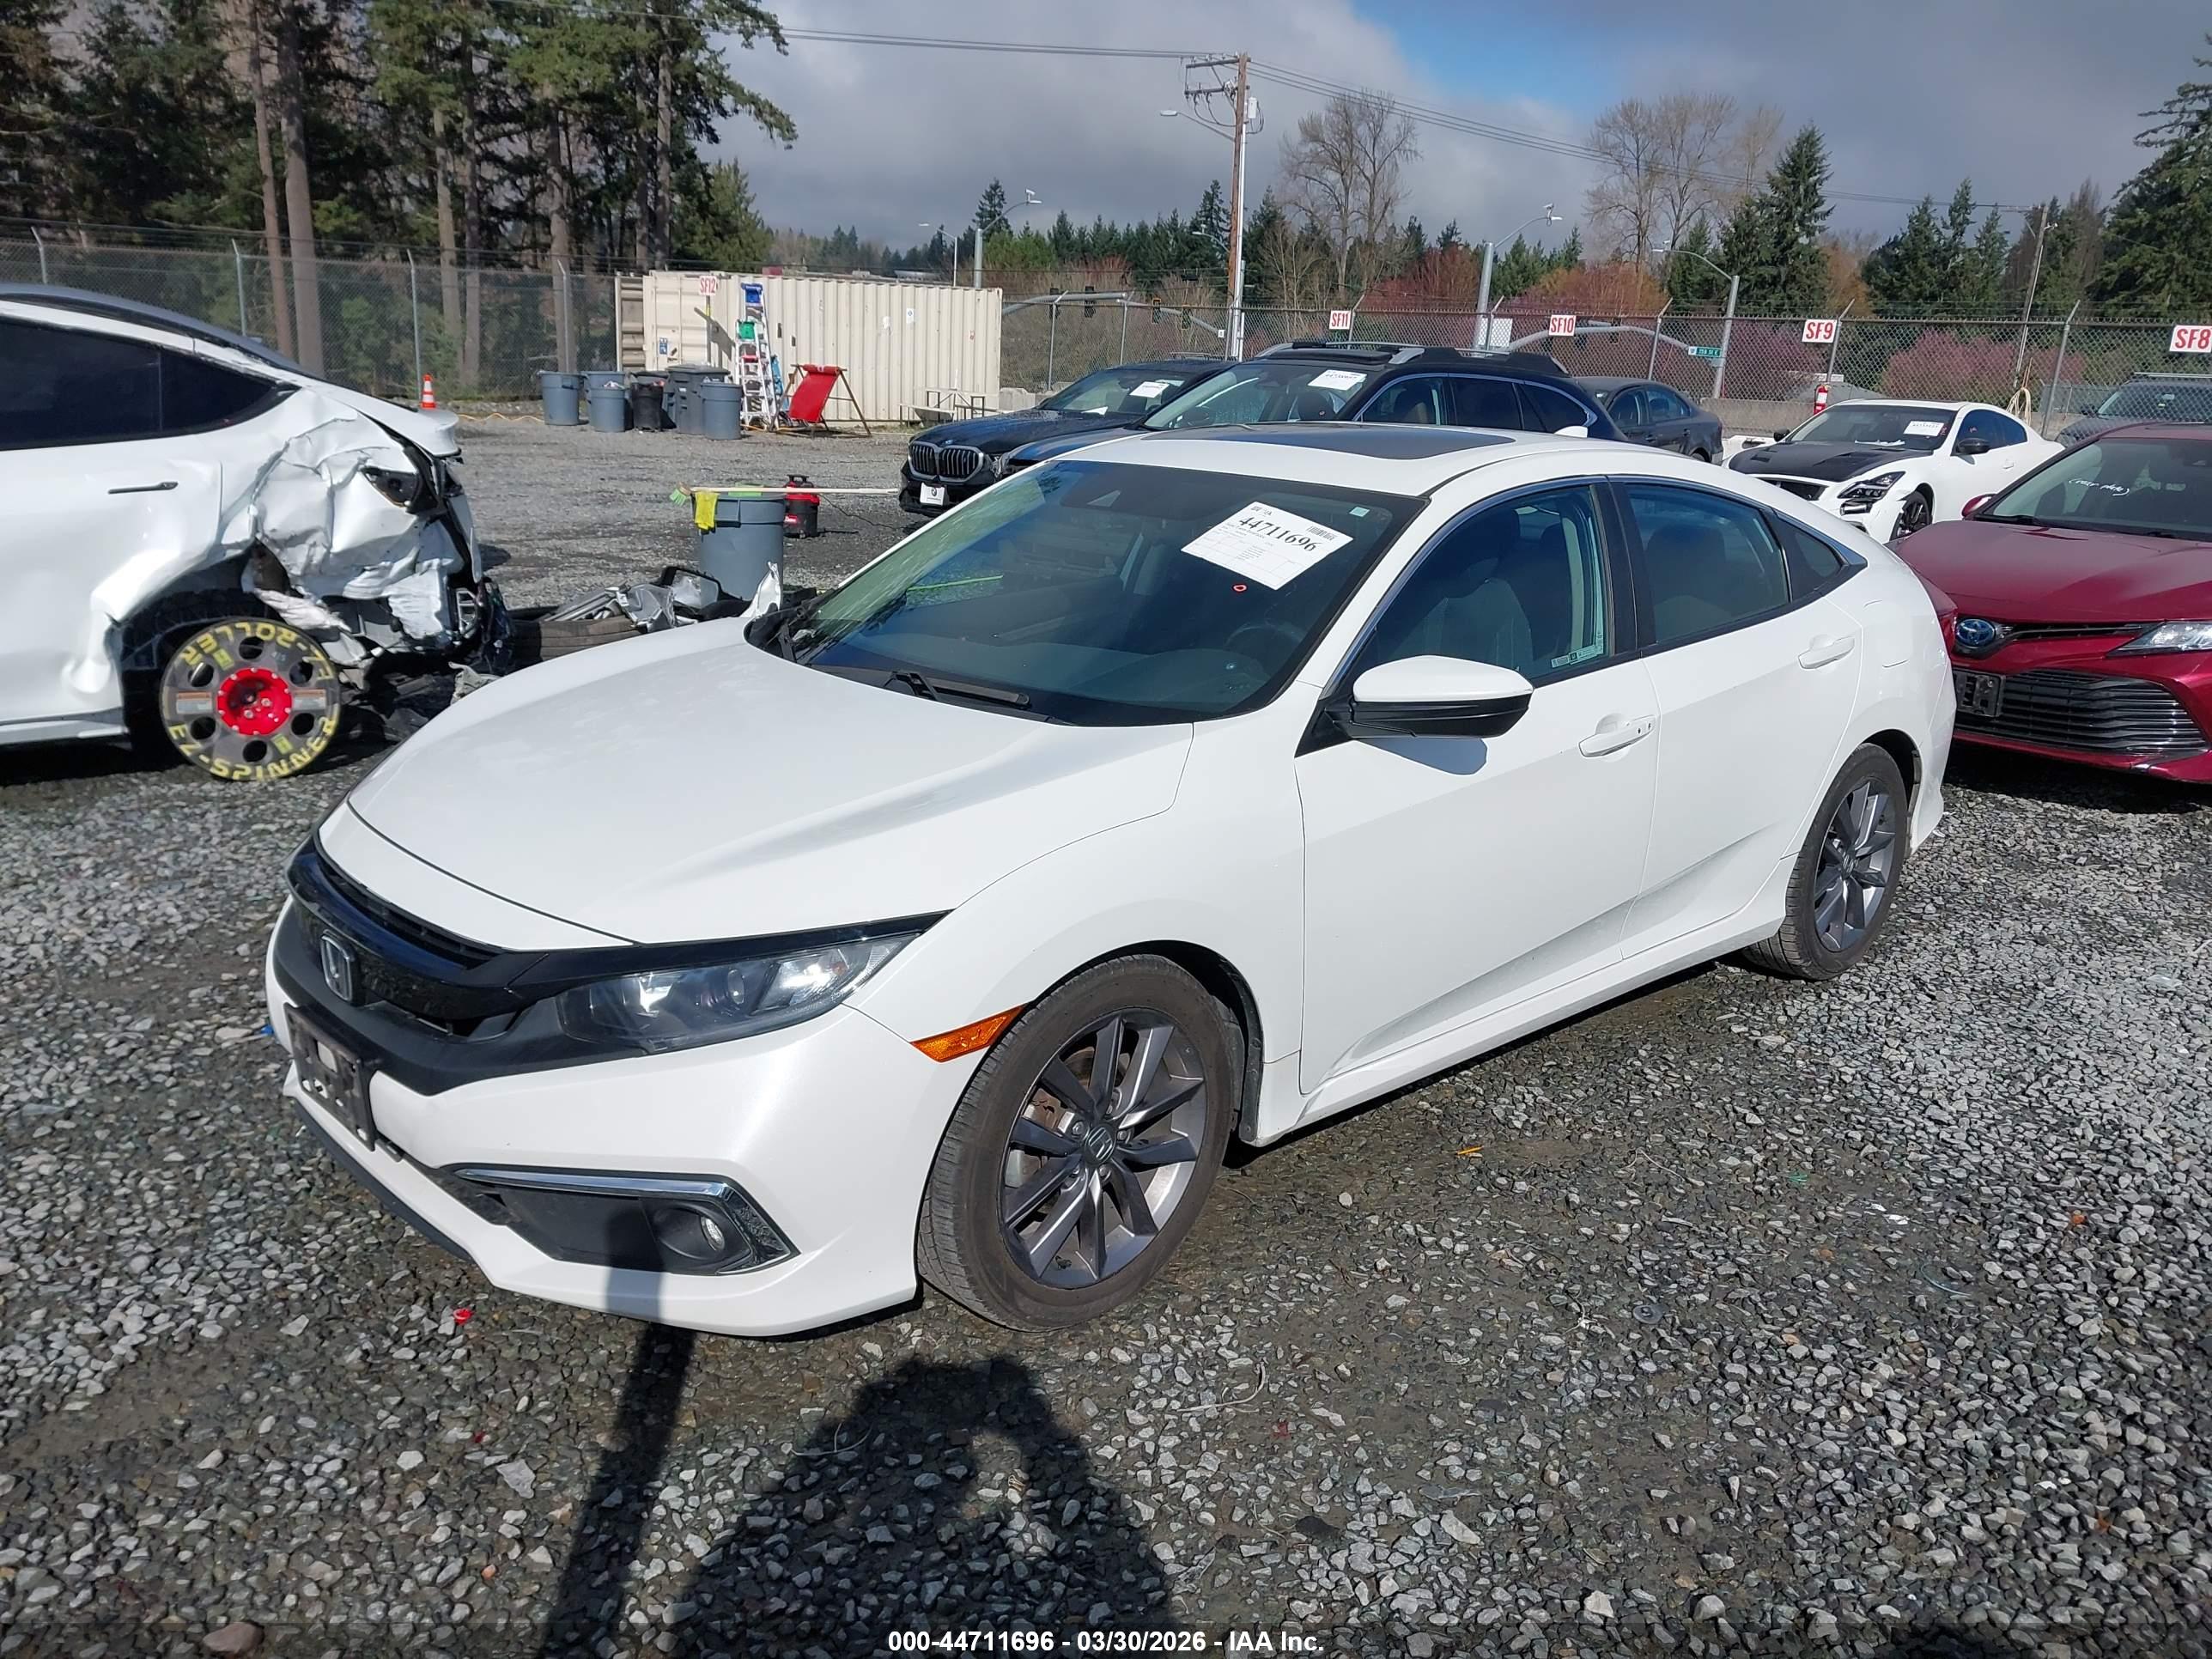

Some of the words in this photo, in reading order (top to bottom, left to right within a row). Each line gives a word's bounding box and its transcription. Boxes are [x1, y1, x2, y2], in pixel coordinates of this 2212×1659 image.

[701, 277, 715, 293] SF12
[1332, 313, 1349, 326] SF11
[1551, 317, 1574, 333] SF10
[1806, 322, 1833, 339] SF9
[2175, 329, 2211, 349] SF8
[1239, 517, 1323, 551] 44711696
[169, 703, 339, 781] EZ-SPINNER
